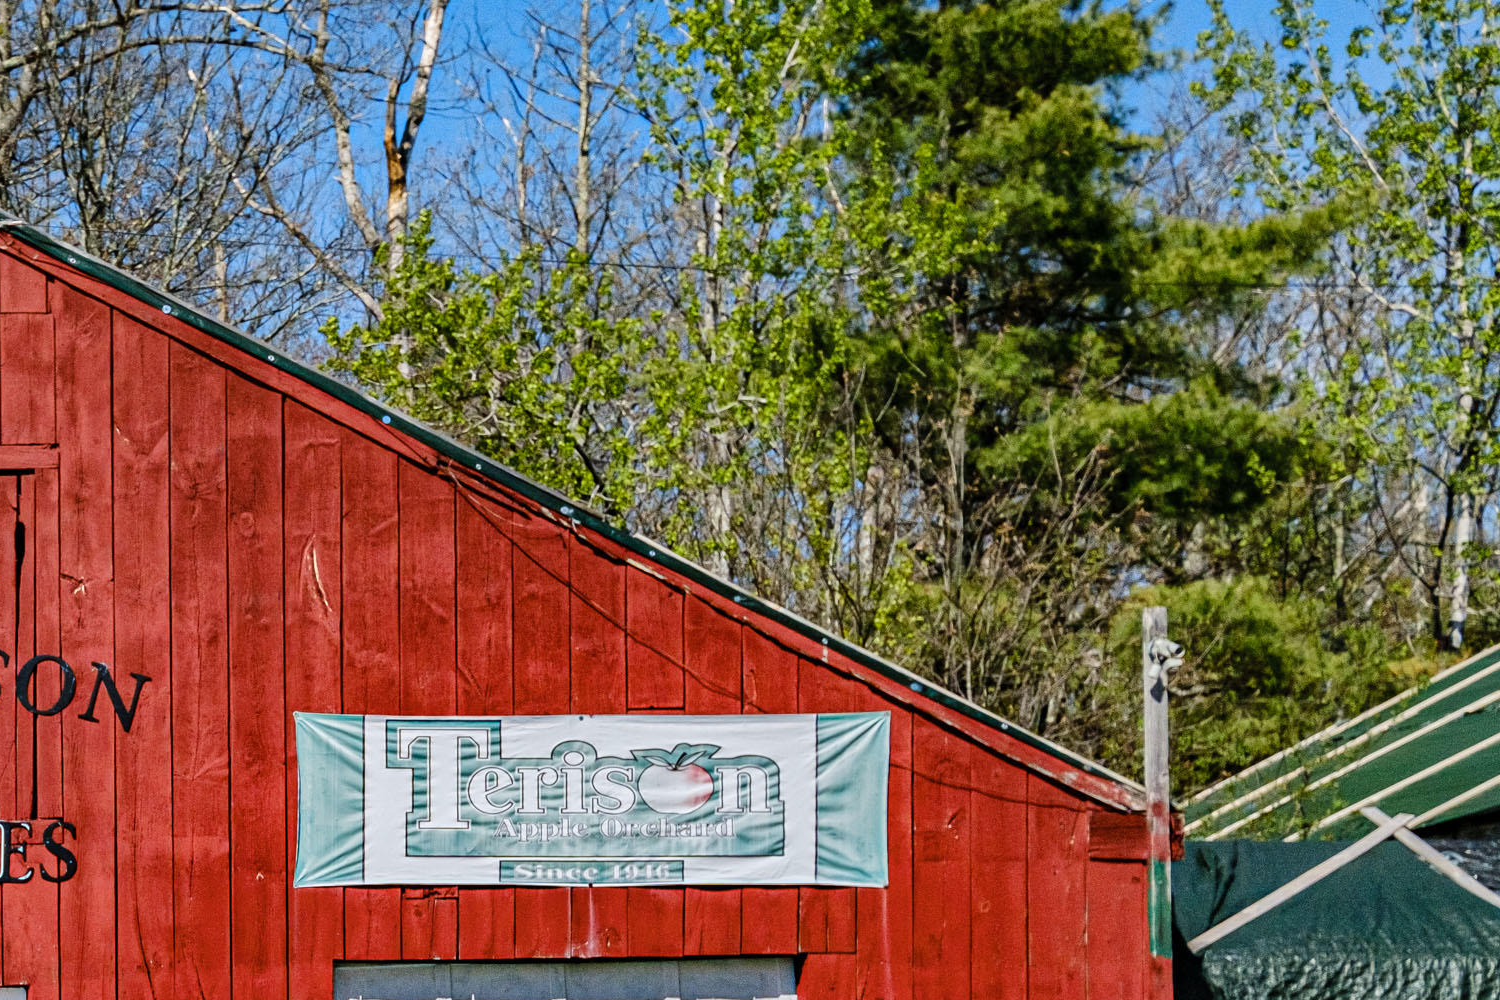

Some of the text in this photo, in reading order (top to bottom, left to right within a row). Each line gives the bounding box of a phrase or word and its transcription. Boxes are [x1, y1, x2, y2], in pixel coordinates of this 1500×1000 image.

[492, 816, 736, 841] Apple Orchard
[514, 862, 599, 881] Since
